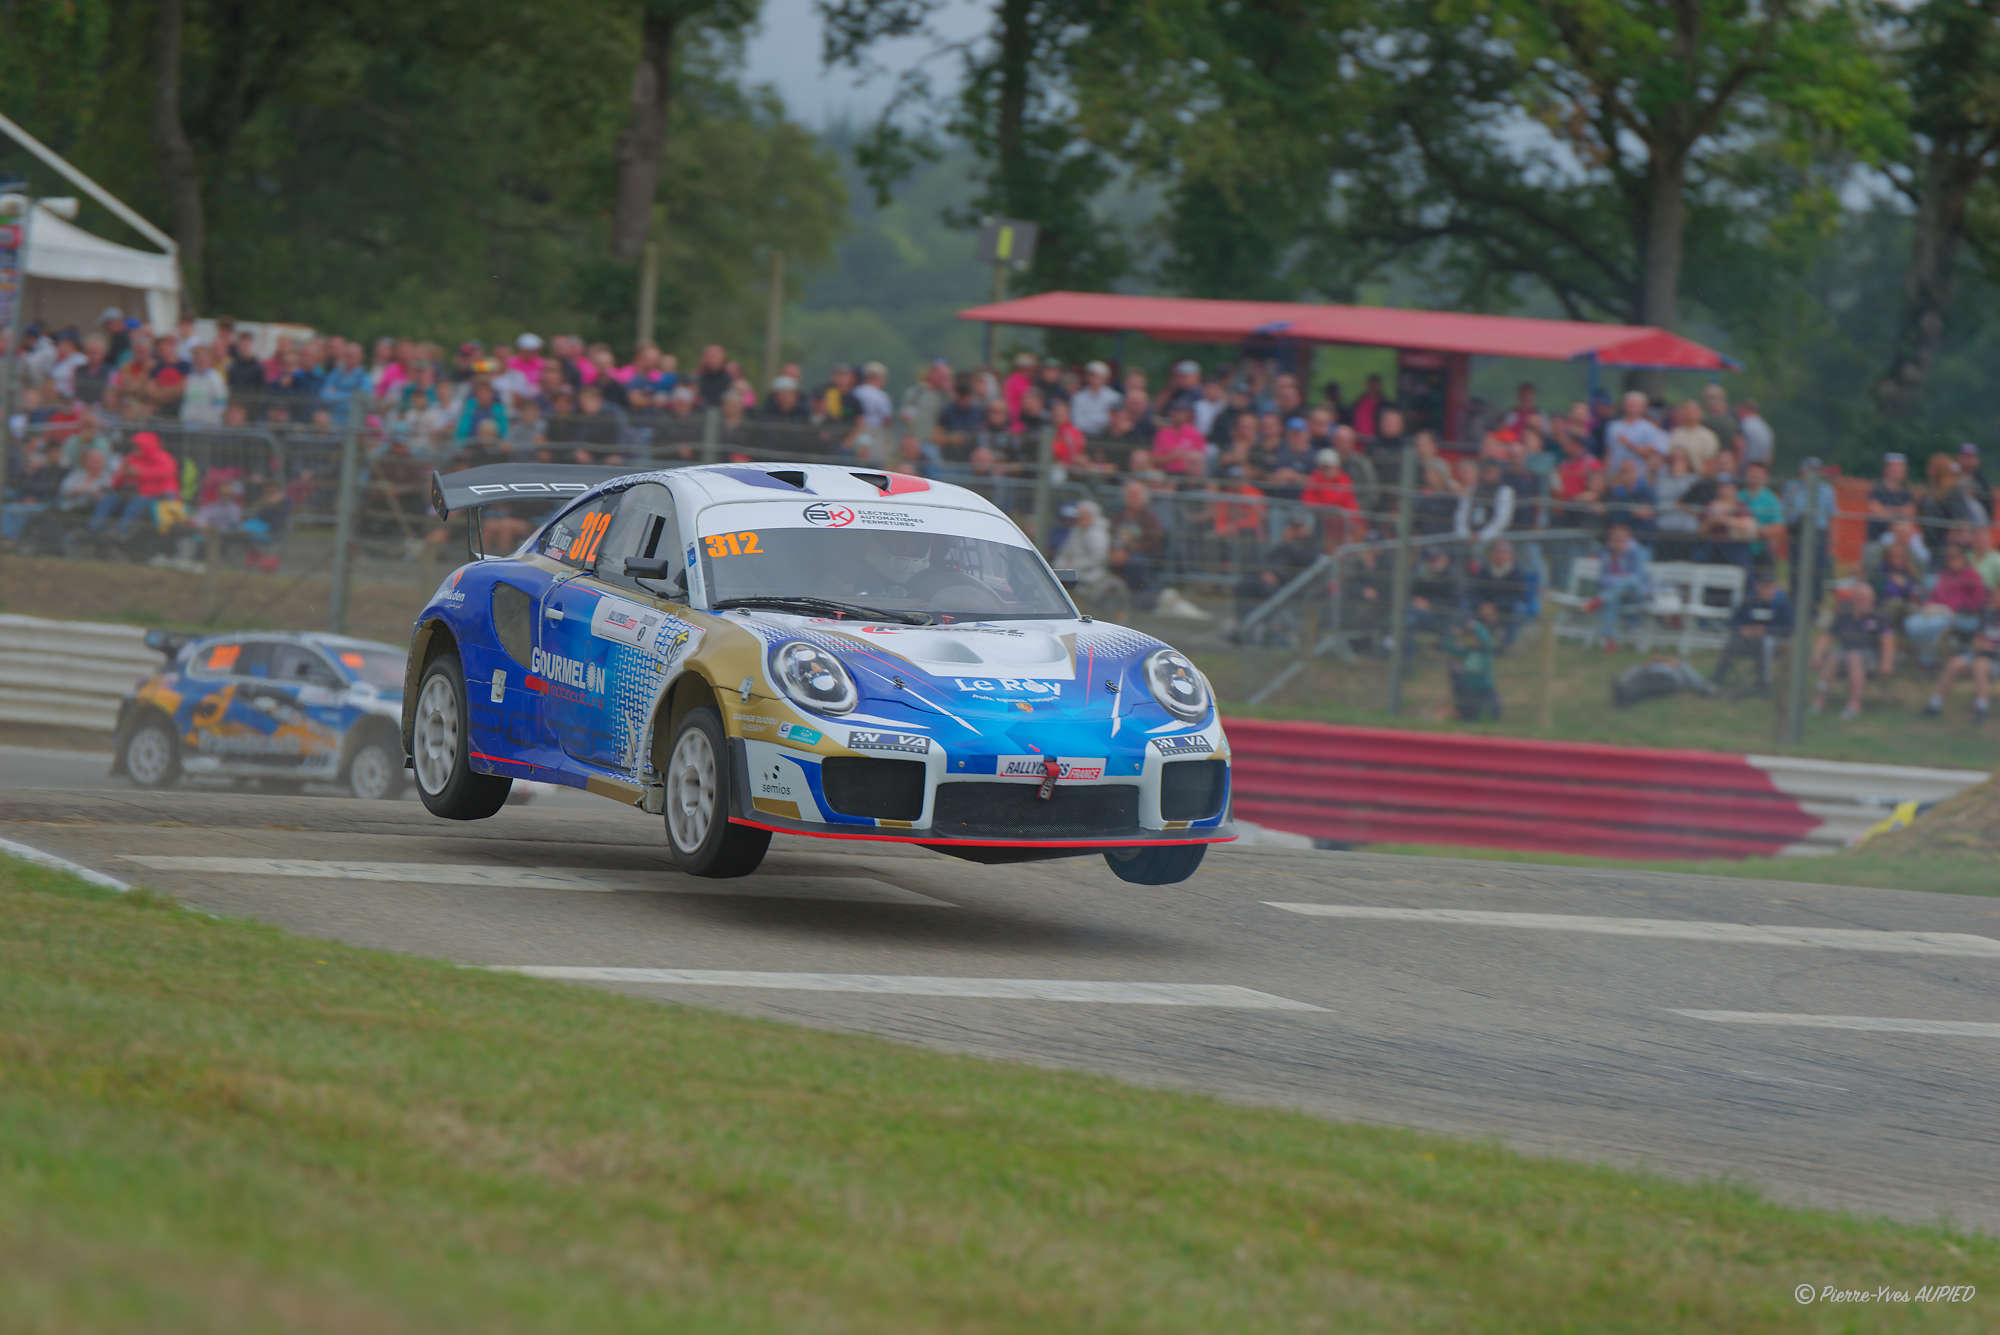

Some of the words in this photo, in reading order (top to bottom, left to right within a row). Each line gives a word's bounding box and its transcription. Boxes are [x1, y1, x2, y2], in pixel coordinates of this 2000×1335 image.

[569, 511, 612, 562] 312
[705, 532, 764, 557] 312
[953, 679, 996, 692] Le
